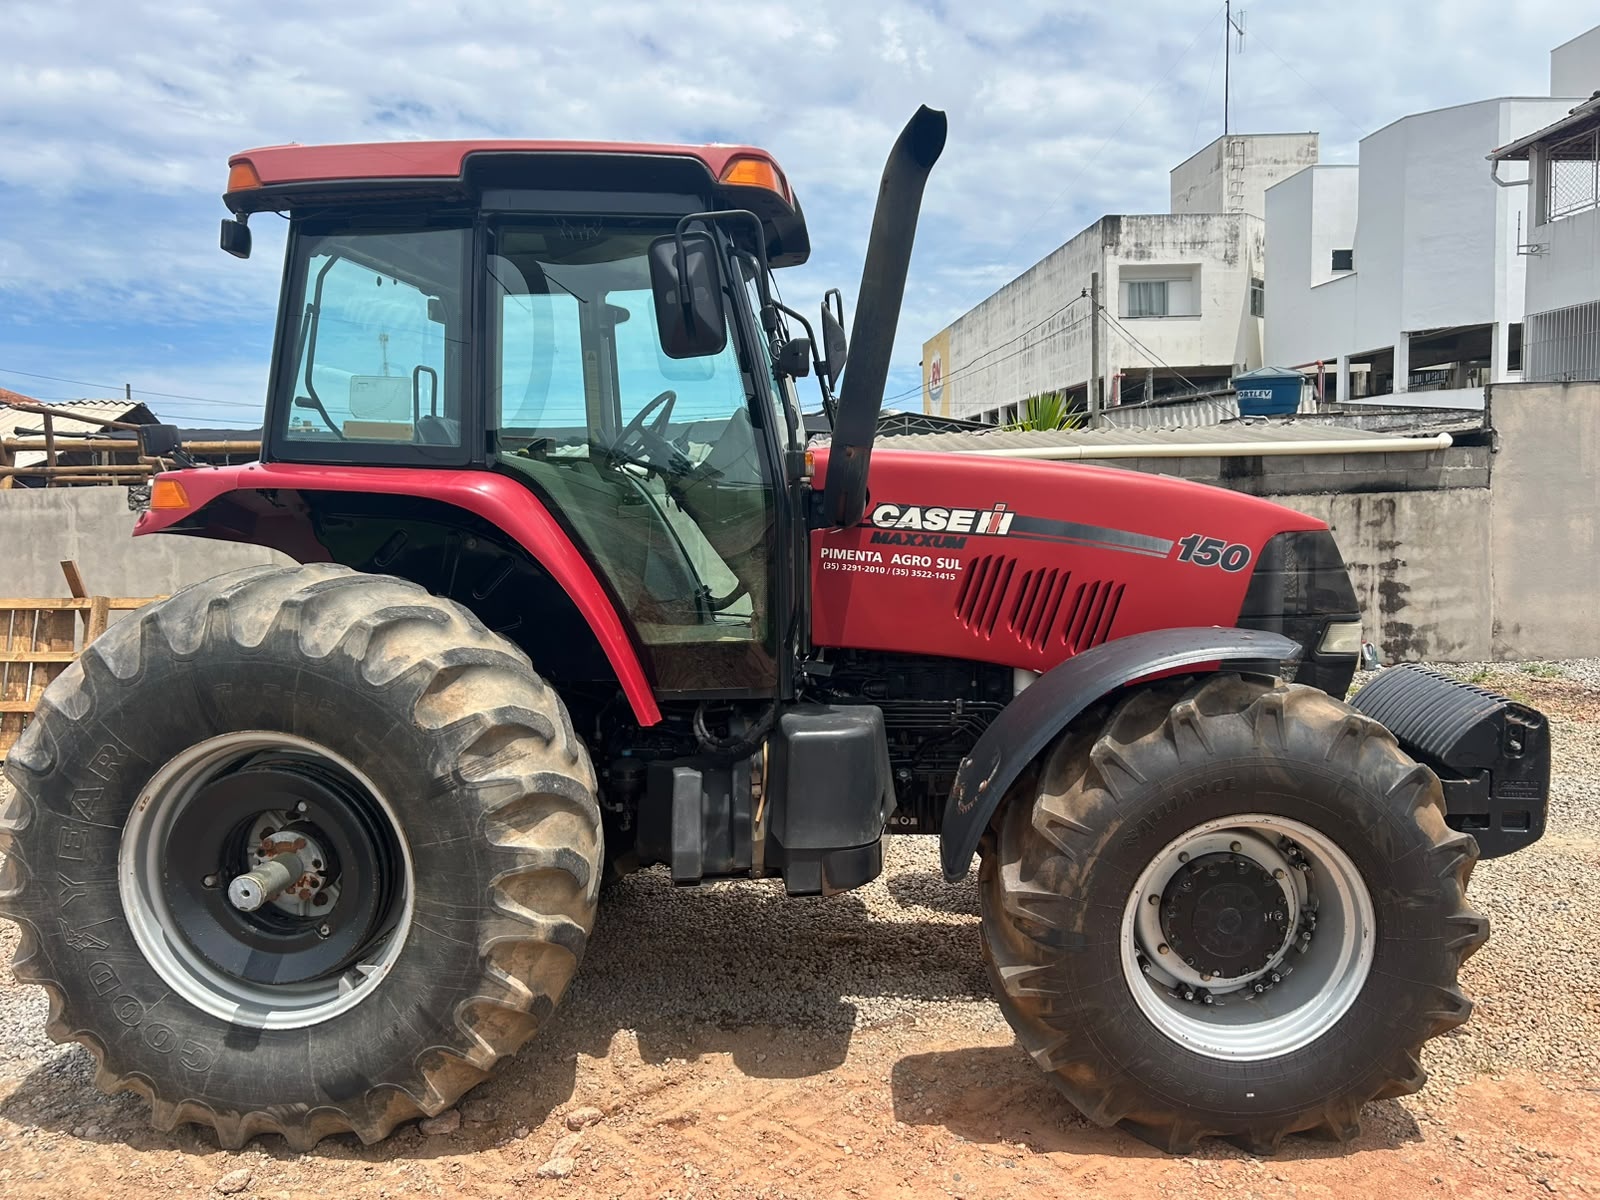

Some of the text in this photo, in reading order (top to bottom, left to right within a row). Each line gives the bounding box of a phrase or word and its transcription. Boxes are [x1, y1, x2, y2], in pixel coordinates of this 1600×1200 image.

[871, 502, 978, 533] CASE
[870, 531, 968, 549] MAXXUM
[1177, 533, 1252, 573] 150
[820, 547, 963, 570] PIMENTA AGRO SUL
[823, 561, 840, 571] (35)
[841, 563, 885, 574] 3291-2010
[892, 567, 909, 577] (35)
[911, 570, 956, 581] 3522-1415
[1136, 776, 1238, 836] ALLIANCE
